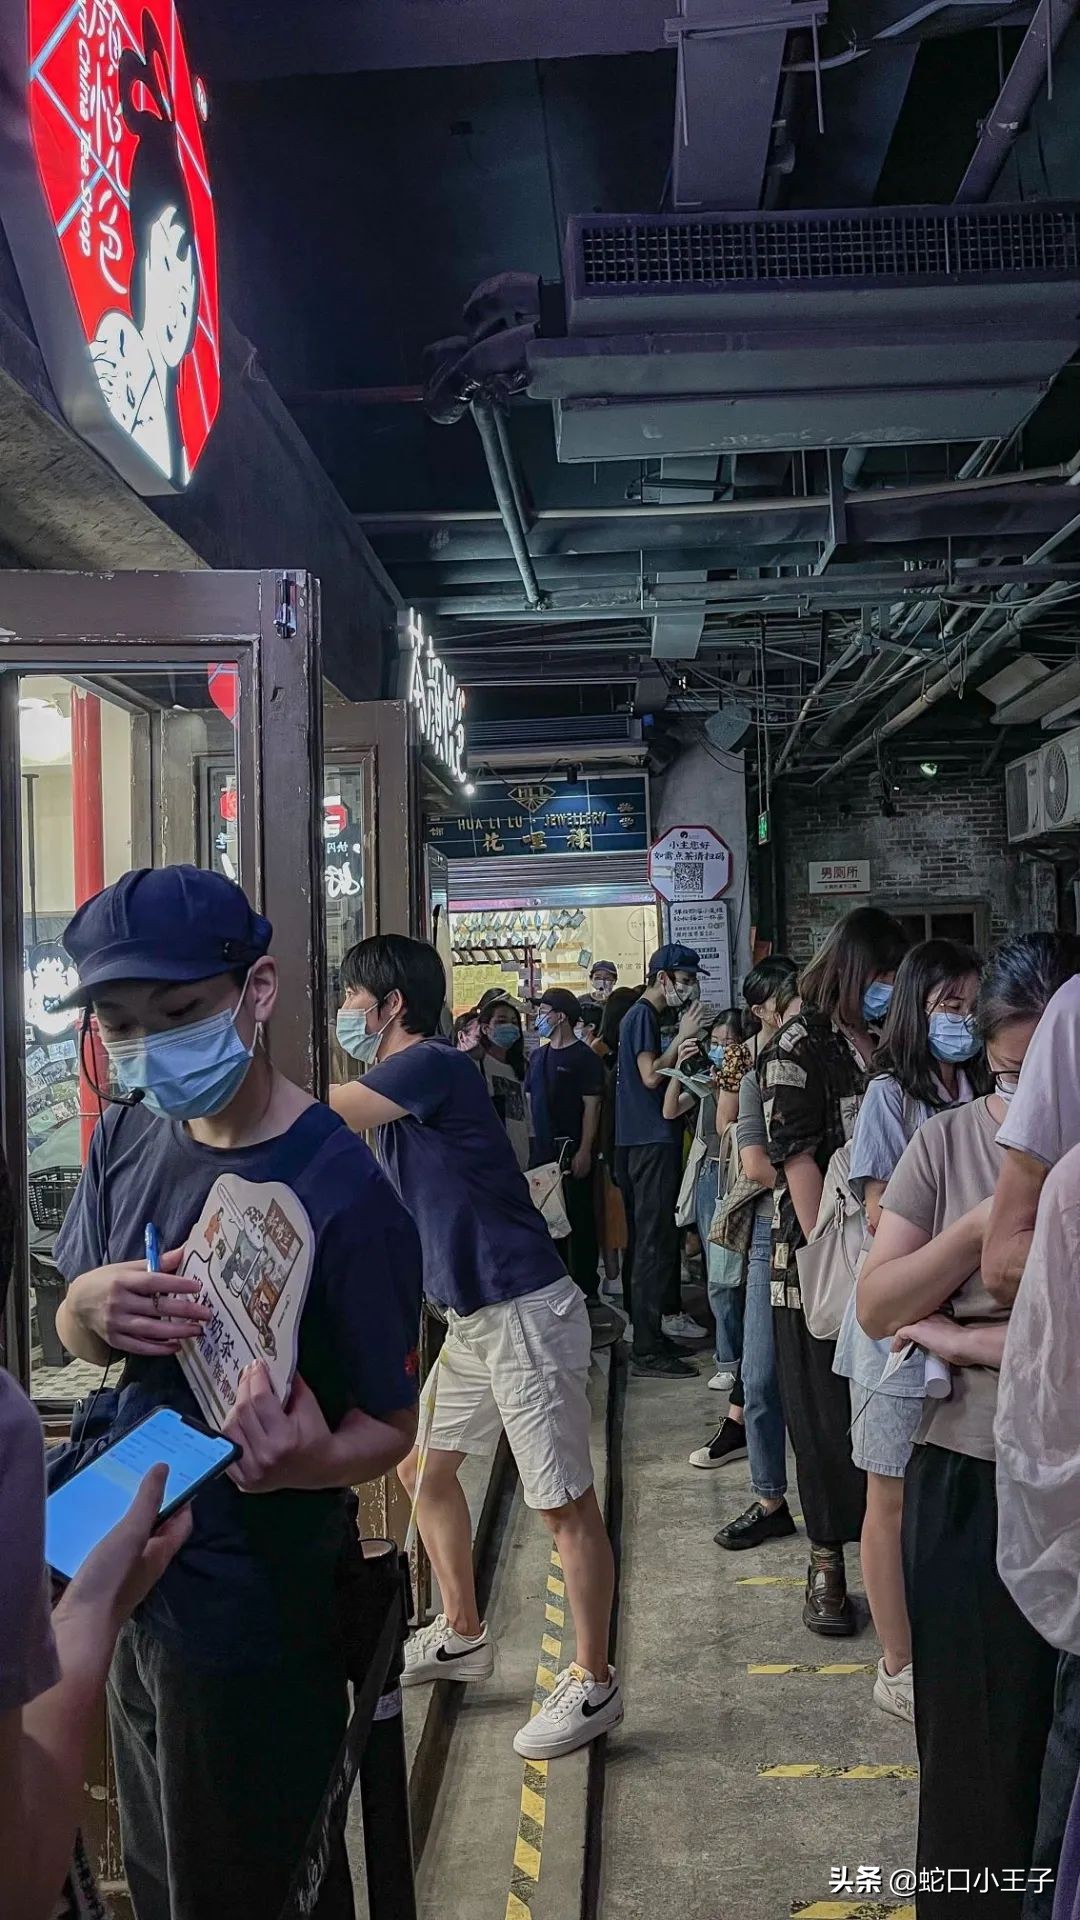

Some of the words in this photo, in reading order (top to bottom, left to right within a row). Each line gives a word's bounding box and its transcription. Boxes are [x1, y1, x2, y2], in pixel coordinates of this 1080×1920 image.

[79, 38, 91, 121] China
[457, 819, 482, 830] HUA
[489, 817, 501, 829] LI
[508, 816, 522, 828] LU
[669, 840, 710, 850] 小主您好
[821, 866, 858, 879] 男厕所
